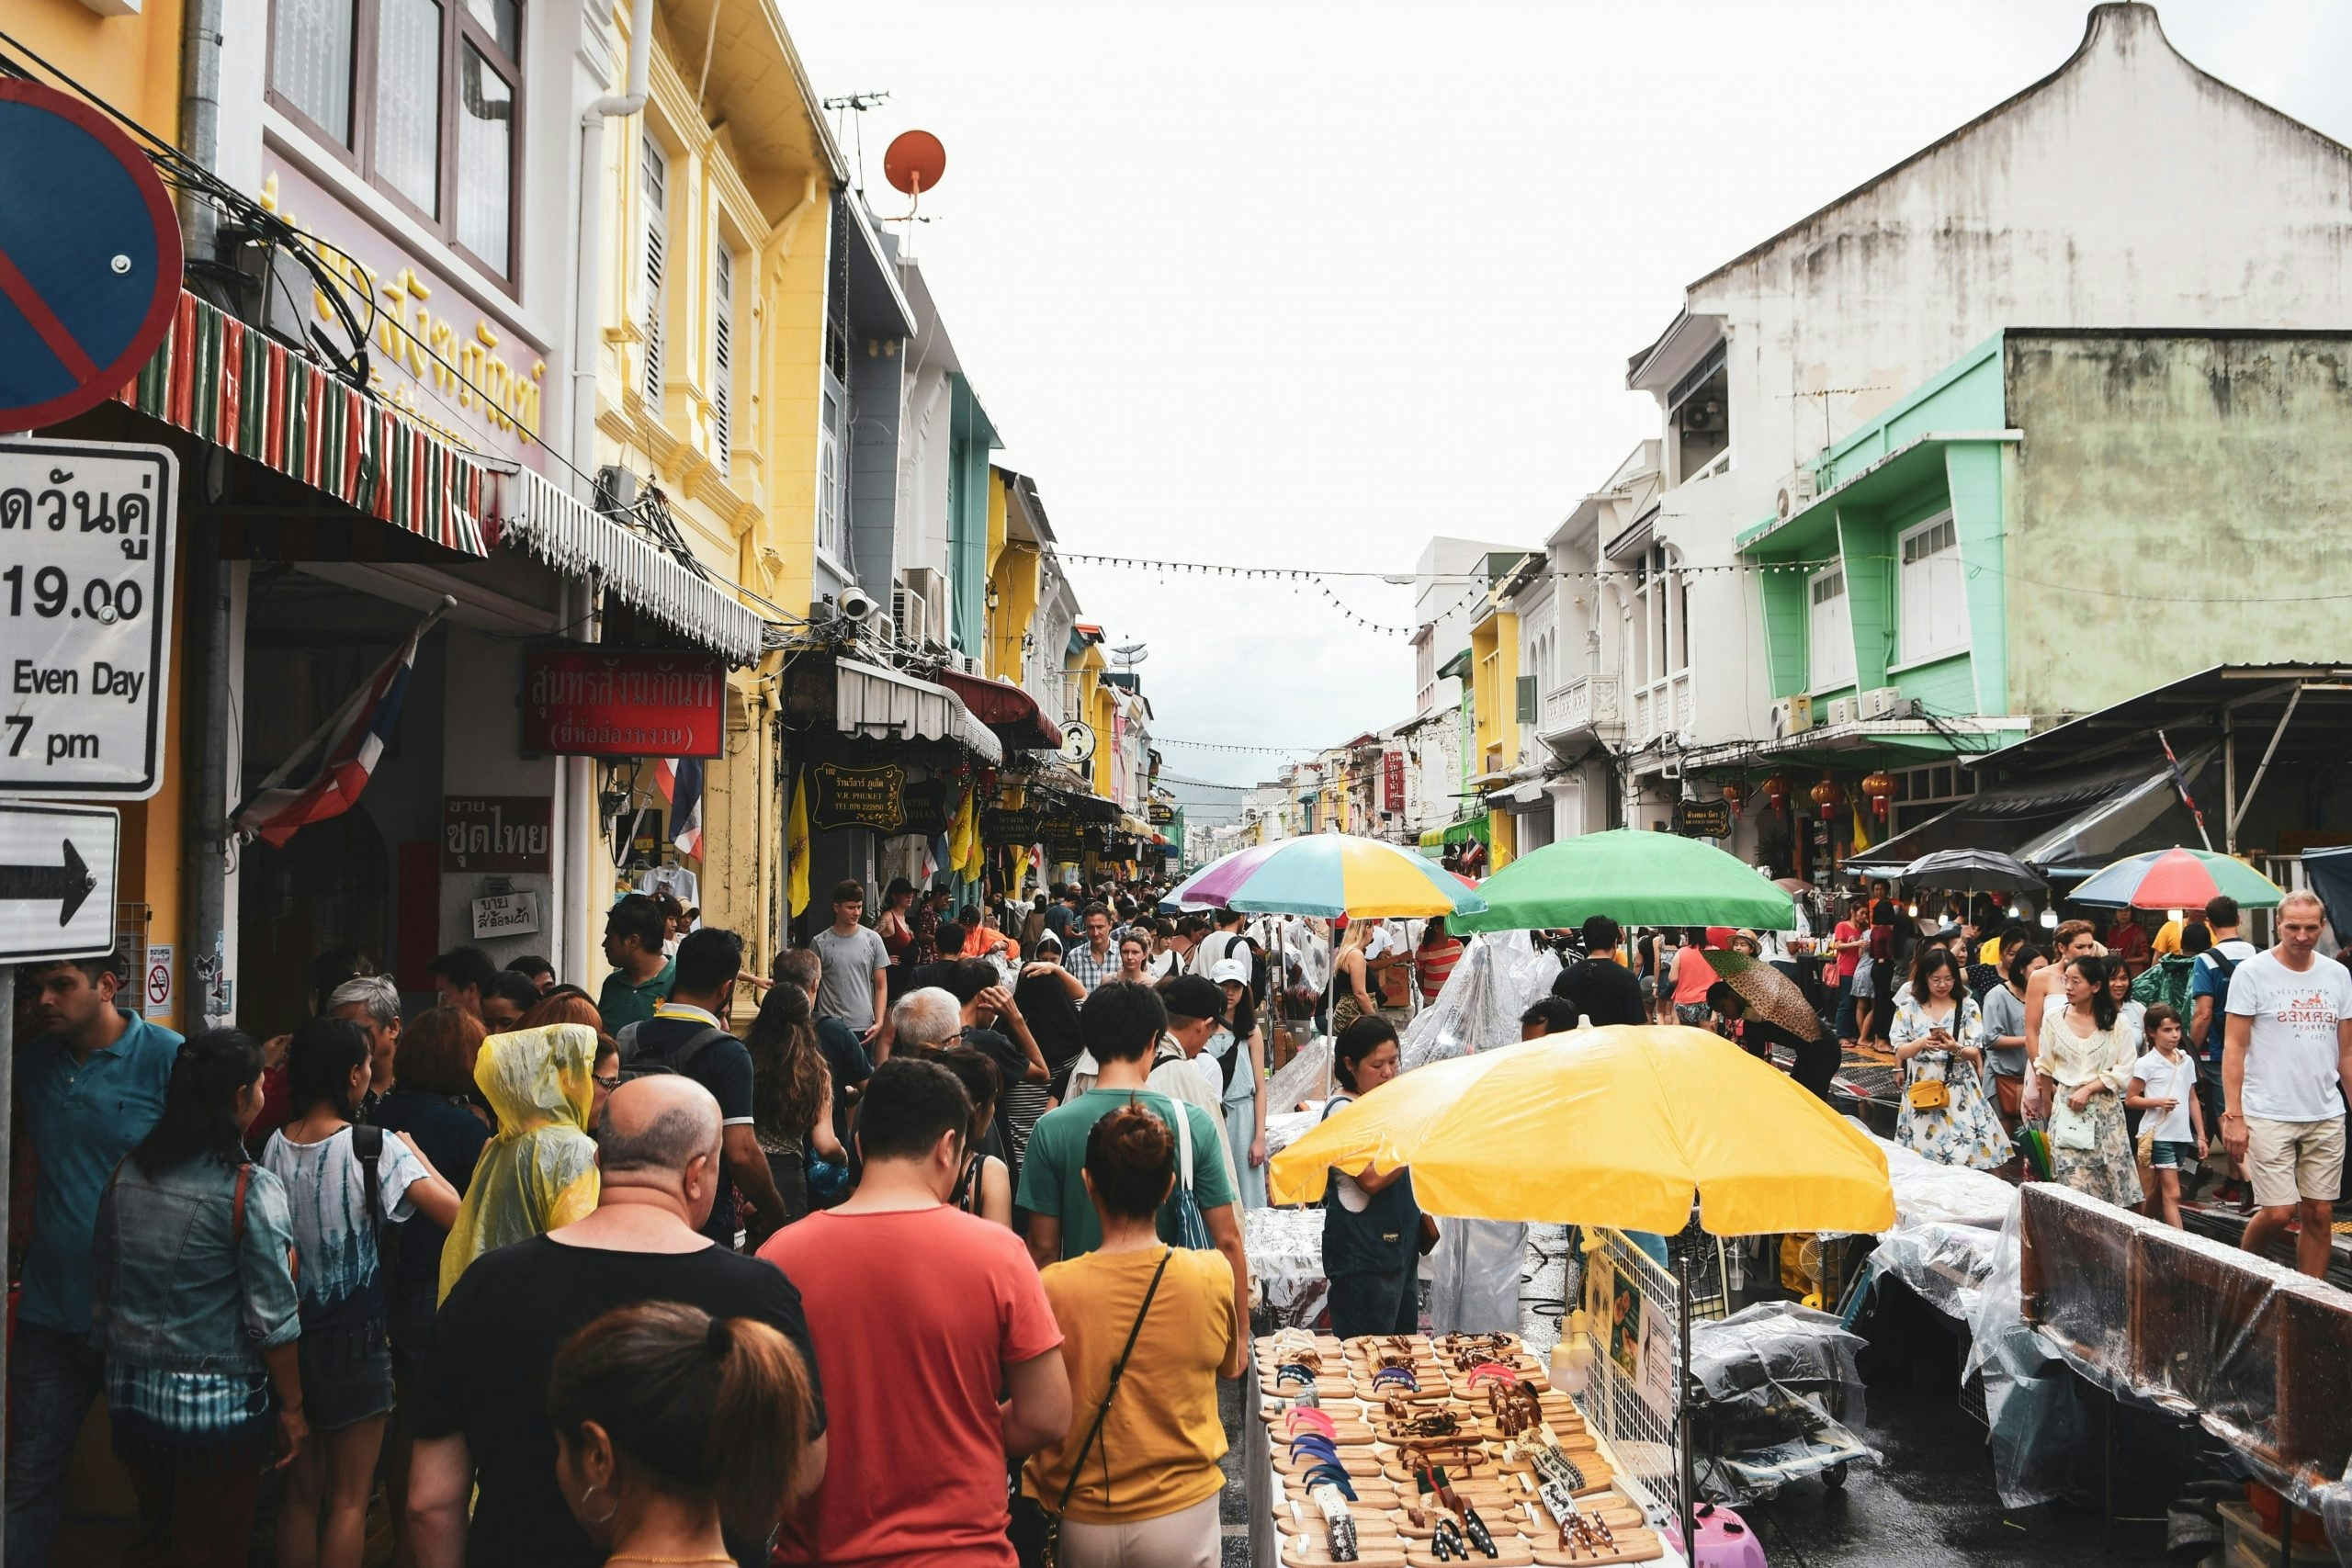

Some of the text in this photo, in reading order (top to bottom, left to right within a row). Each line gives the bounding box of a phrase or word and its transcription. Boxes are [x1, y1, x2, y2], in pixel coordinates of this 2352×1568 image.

[0, 468, 152, 560] ดวันคู่
[3, 565, 142, 622] 19.00
[13, 660, 145, 704] Even Day
[5, 716, 99, 766] 7 pm
[447, 806, 548, 868] ชุดไทย
